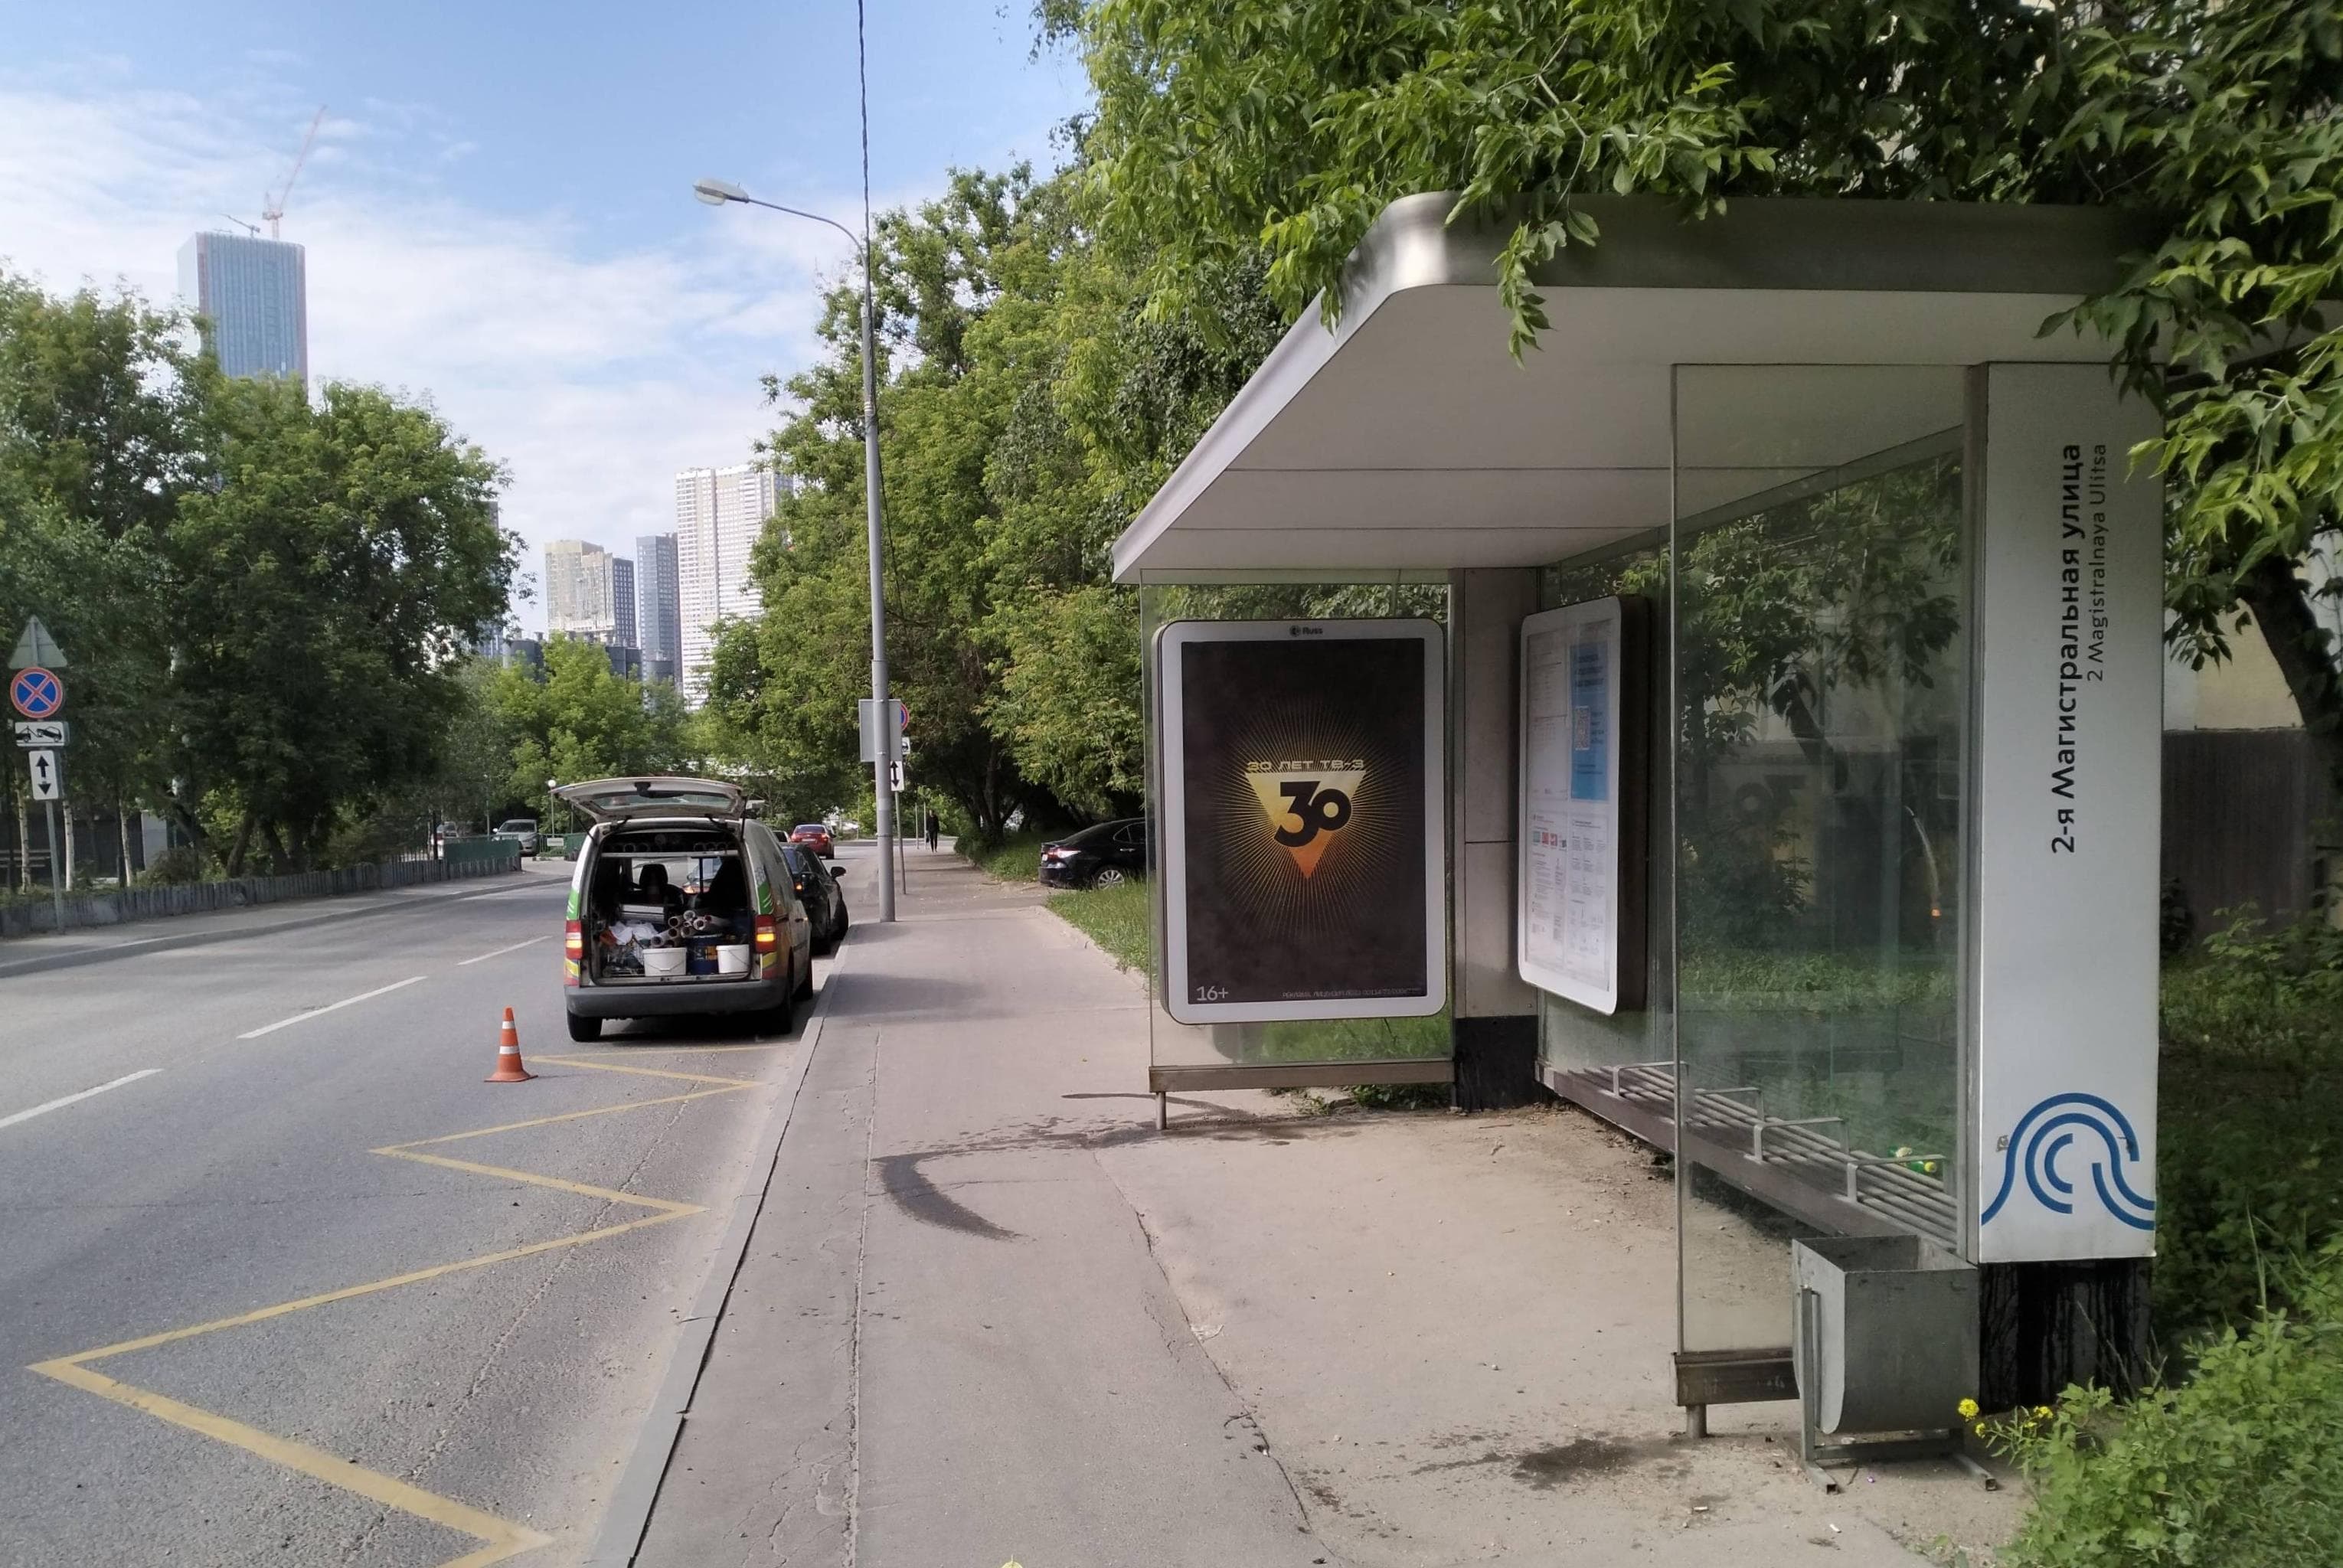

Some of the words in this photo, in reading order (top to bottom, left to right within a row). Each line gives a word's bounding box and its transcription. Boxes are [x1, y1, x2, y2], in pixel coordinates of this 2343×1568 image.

[2062, 444, 2086, 539] улица
[2088, 444, 2106, 505] Ulitsa
[2087, 512, 2109, 663] Magistralnaya
[2051, 549, 2083, 799] Магистральная
[2086, 669, 2103, 681] 2
[1247, 761, 1271, 771] 30
[1279, 760, 1314, 769] ЛЕТ
[1320, 760, 1364, 769] ТВ-3
[1273, 780, 1352, 848] 30
[2051, 808, 2075, 854] 2-я
[1196, 985, 1229, 1001] 16+
